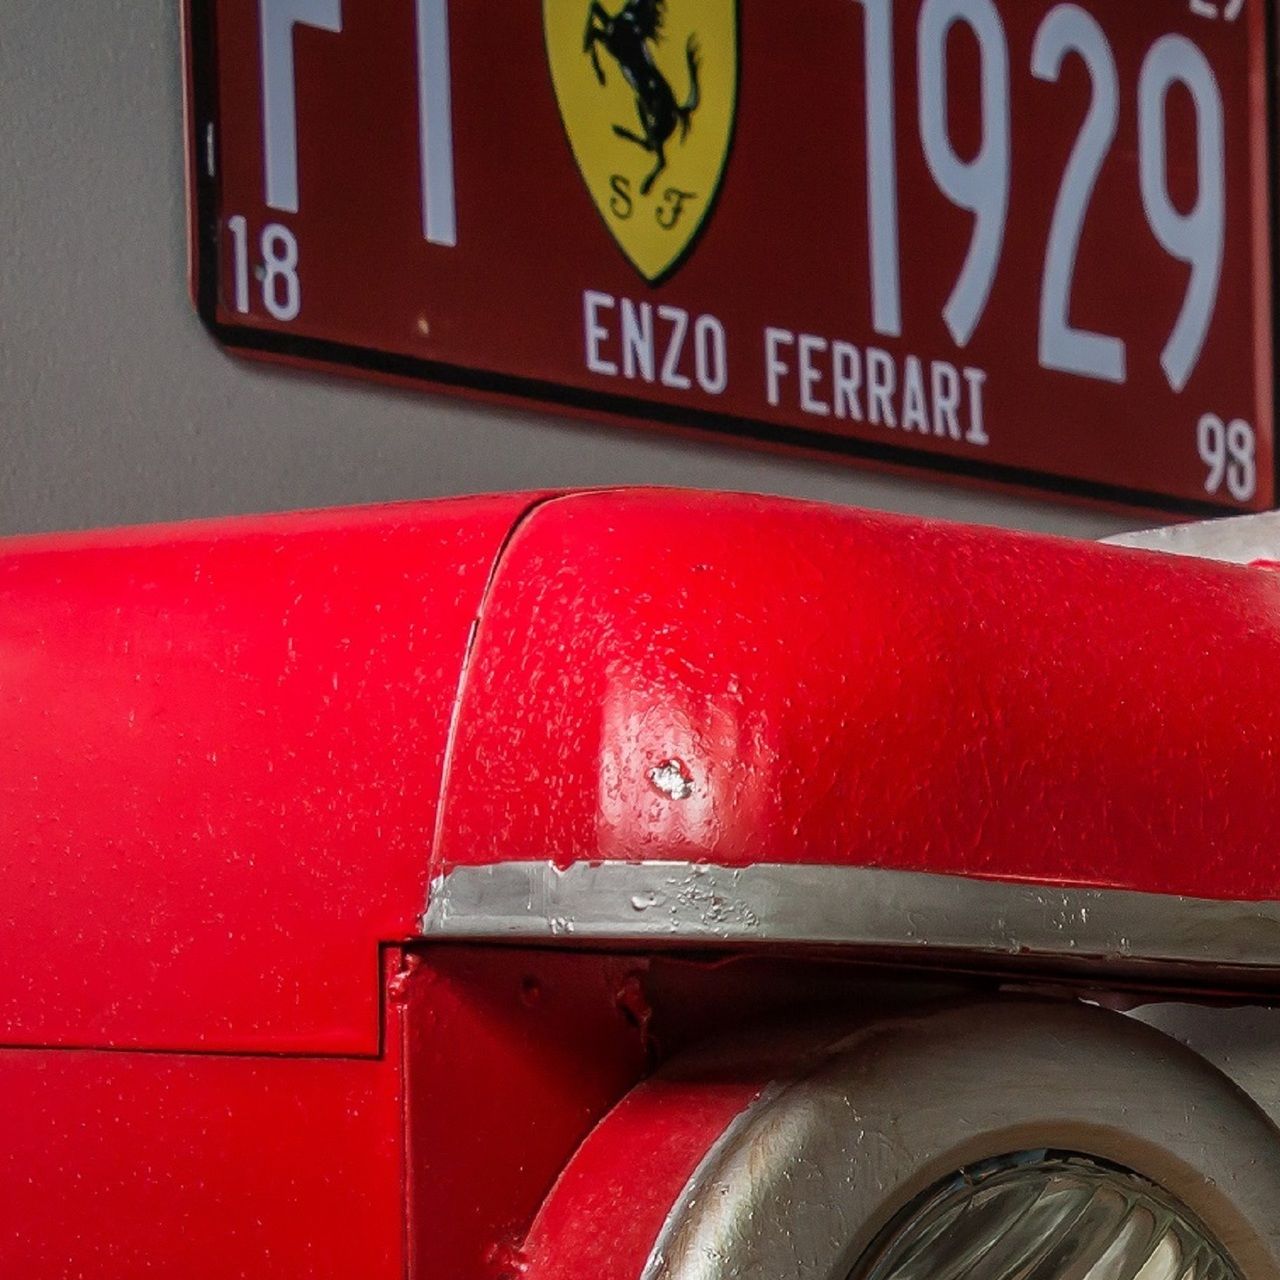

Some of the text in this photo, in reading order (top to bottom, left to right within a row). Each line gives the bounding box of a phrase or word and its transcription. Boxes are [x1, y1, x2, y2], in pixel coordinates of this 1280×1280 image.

[863, 0, 1227, 394] 1929
[227, 214, 301, 322] 18
[582, 290, 990, 446] ENZO FERRARI
[1196, 412, 1257, 501] 98
